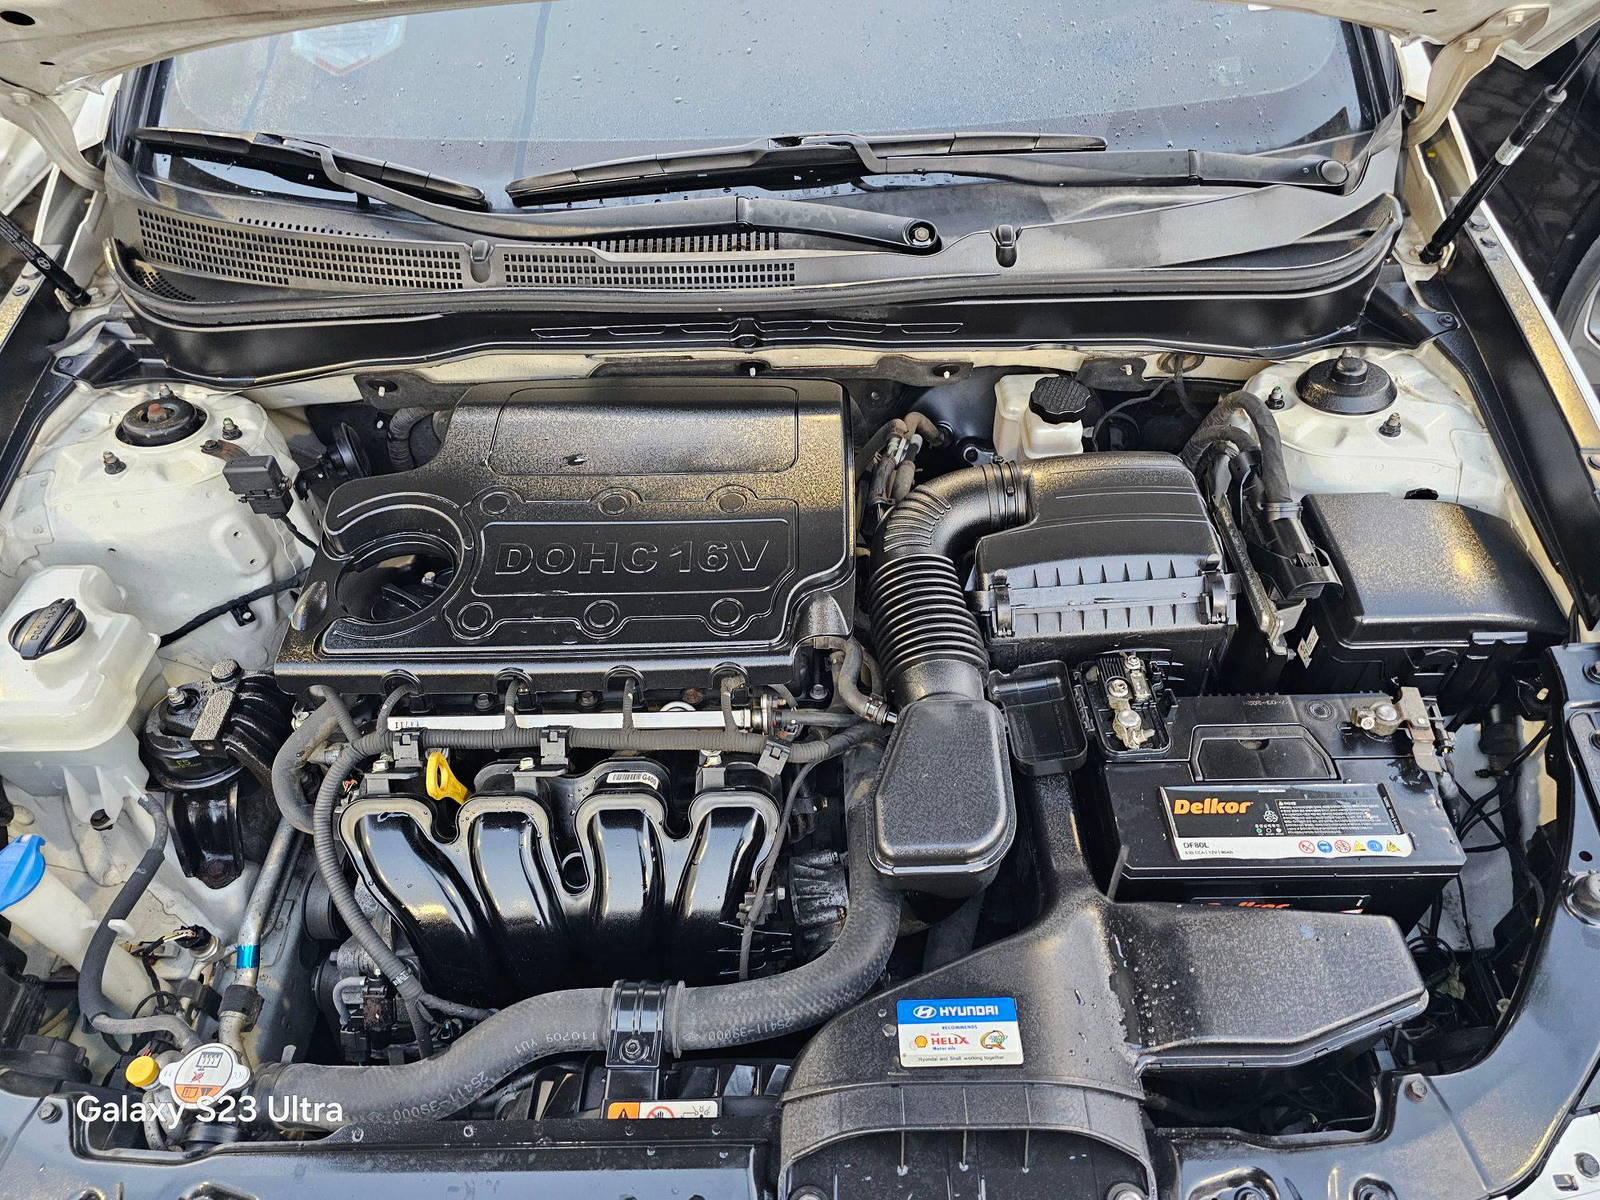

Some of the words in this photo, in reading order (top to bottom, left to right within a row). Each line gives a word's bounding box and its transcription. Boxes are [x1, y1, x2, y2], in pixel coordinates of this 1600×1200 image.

[495, 542, 658, 575] DOHC
[669, 539, 770, 573] 16V
[1174, 798, 1251, 815] Delkor
[940, 1005, 999, 1017] HYUNDAI
[931, 1036, 970, 1045] HELIX
